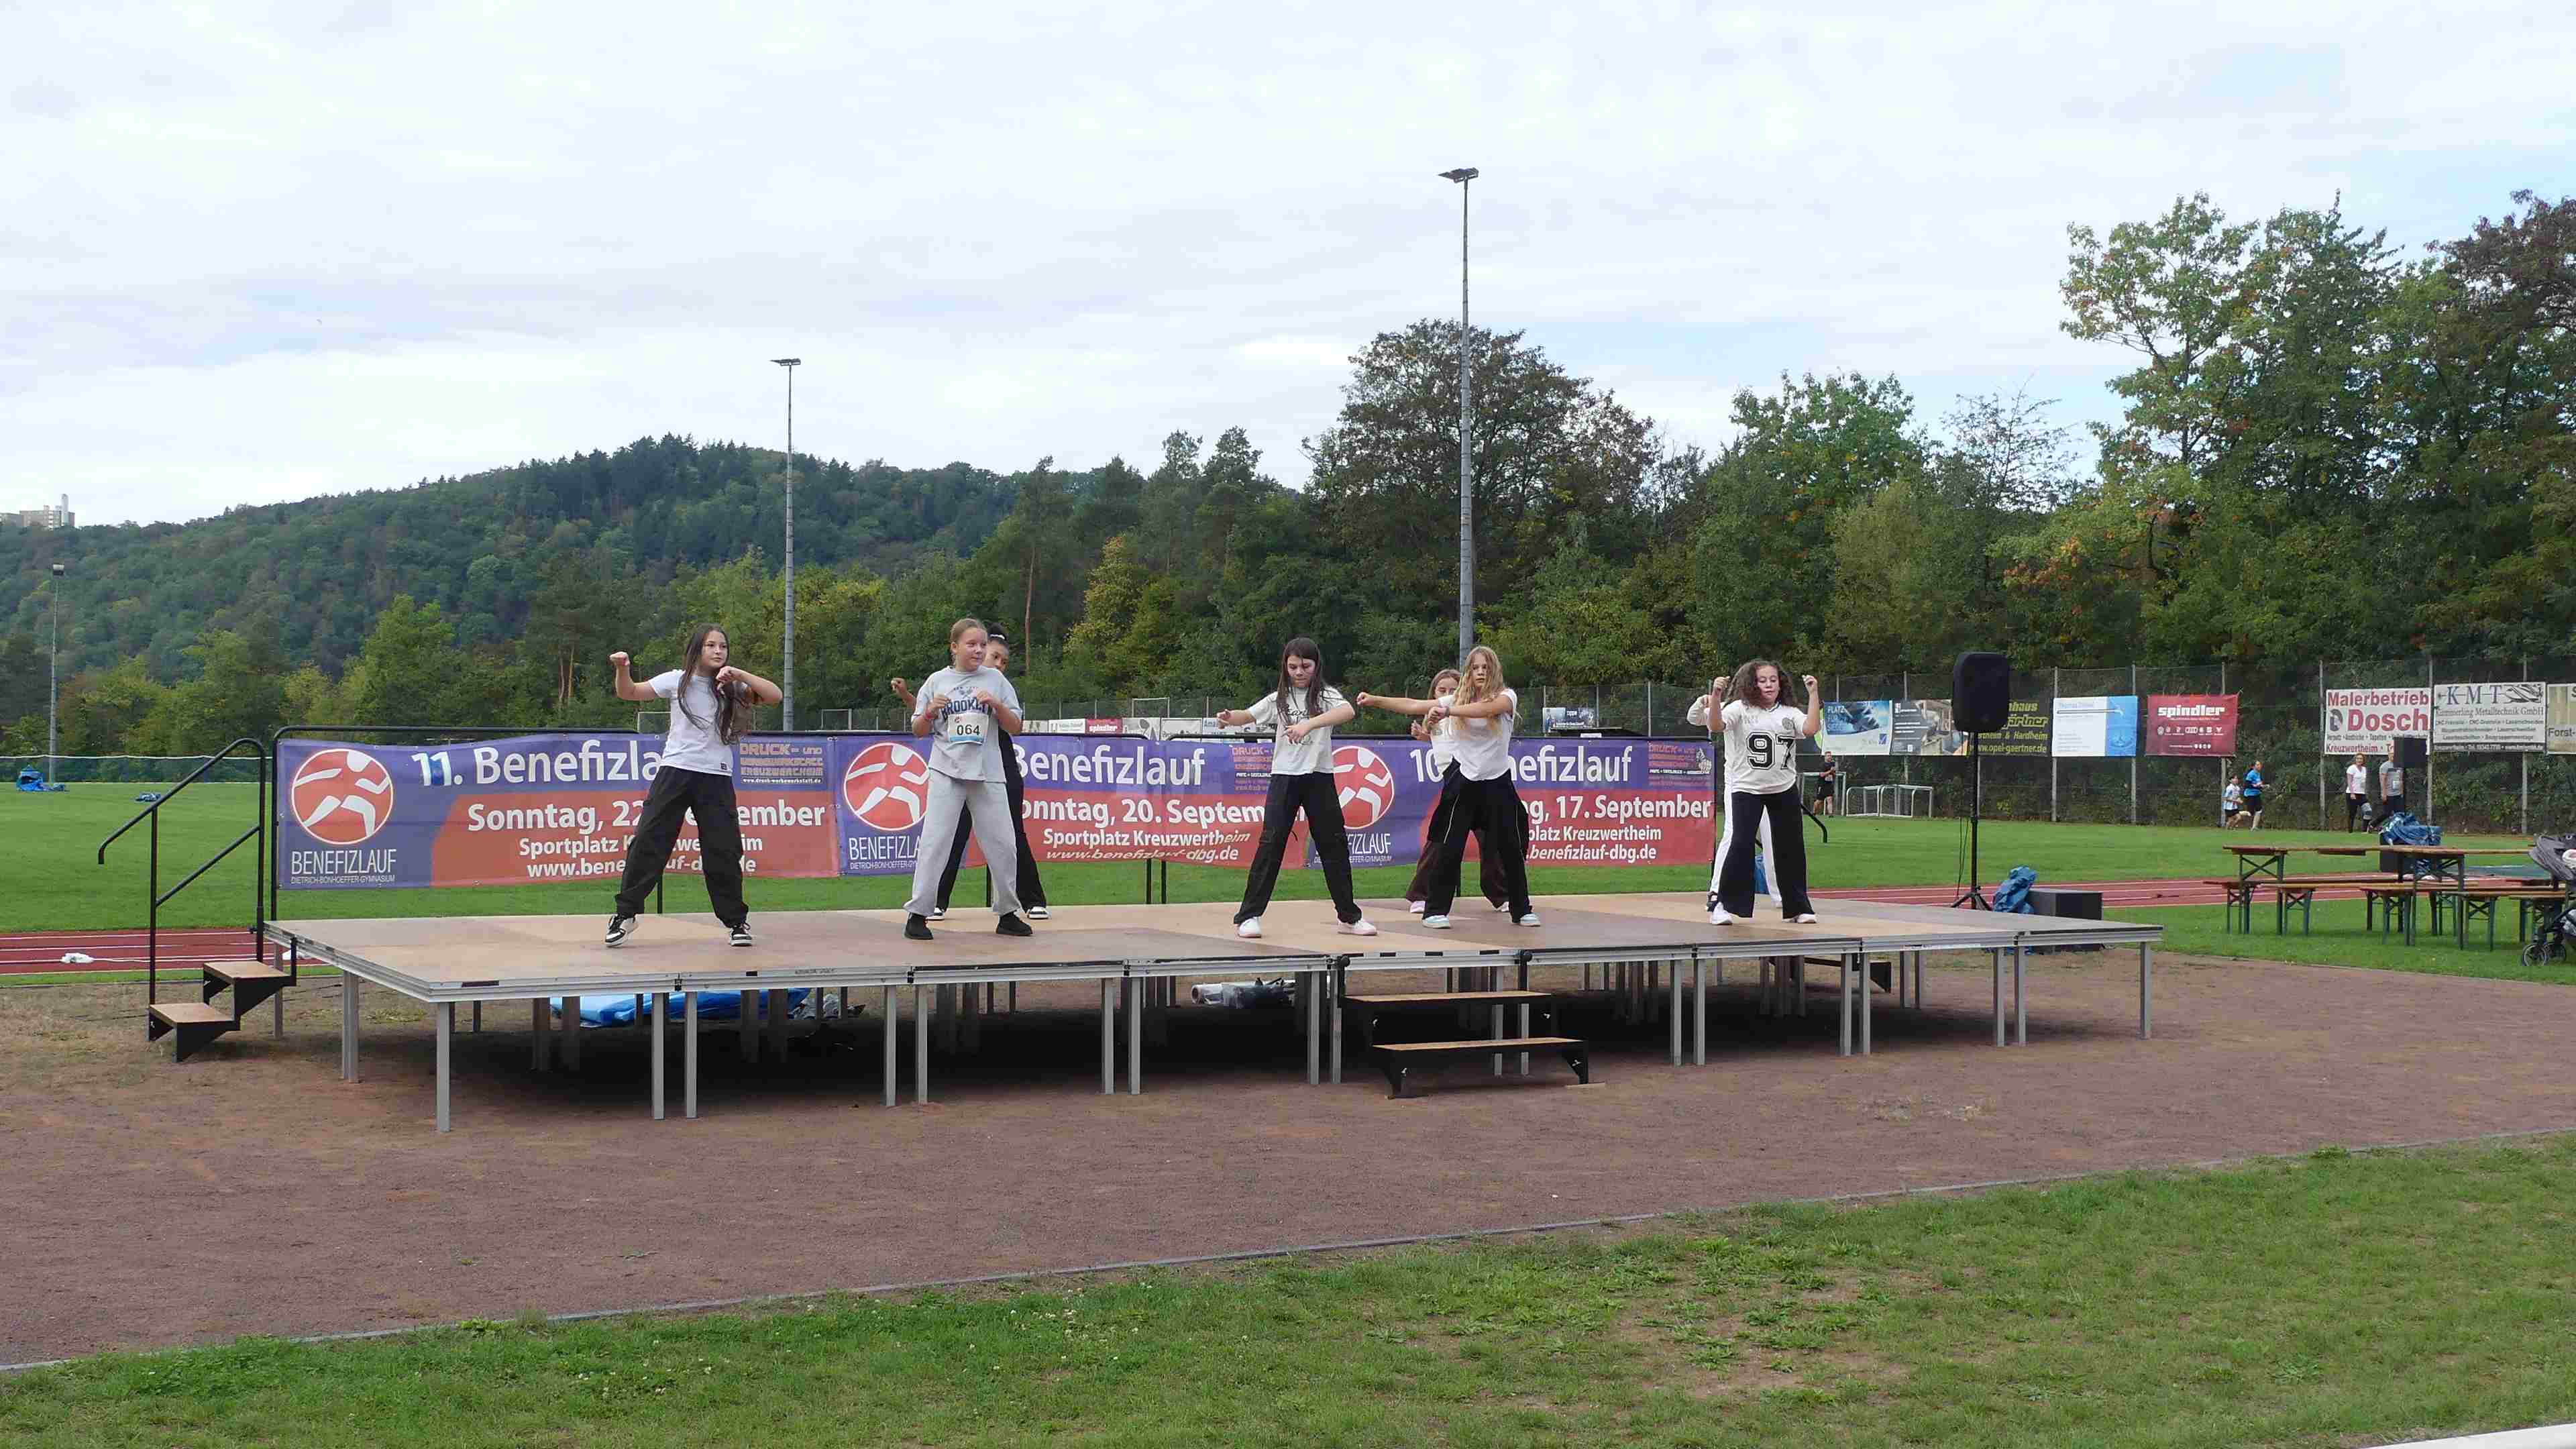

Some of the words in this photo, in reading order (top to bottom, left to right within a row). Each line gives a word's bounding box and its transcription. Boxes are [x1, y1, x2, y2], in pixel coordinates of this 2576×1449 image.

[2328, 690, 2429, 706] Malerbetrieb
[2008, 714, 2048, 728] ärtner
[2157, 704, 2225, 718] spindler
[2348, 708, 2428, 731] Dosch
[2521, 706, 2544, 716] GmbH
[957, 724, 980, 736] 064
[1746, 732, 1795, 770] 97
[411, 751, 464, 787] 11.
[474, 739, 663, 784] Benefizla
[1410, 748, 1443, 784] 10
[1507, 745, 1633, 783] nefizlauf
[468, 803, 604, 835] Sonntag,
[1022, 798, 1116, 829] onntag,
[1121, 798, 1162, 824] 20.
[1556, 796, 1590, 819] 17.
[1594, 794, 1711, 824] September
[1042, 828, 1130, 849] Sportplatz
[1133, 828, 1251, 847] Kreuzwertheim
[1347, 833, 1391, 855] FIZLAUF
[1563, 824, 1662, 842] Kreuzwertheim
[519, 836, 619, 859] Sportplatz
[849, 835, 921, 860] BENEFIZLA
[1526, 843, 1657, 863] .benefizlauf-dbg.de
[291, 849, 396, 875] BENEFIZLAUF
